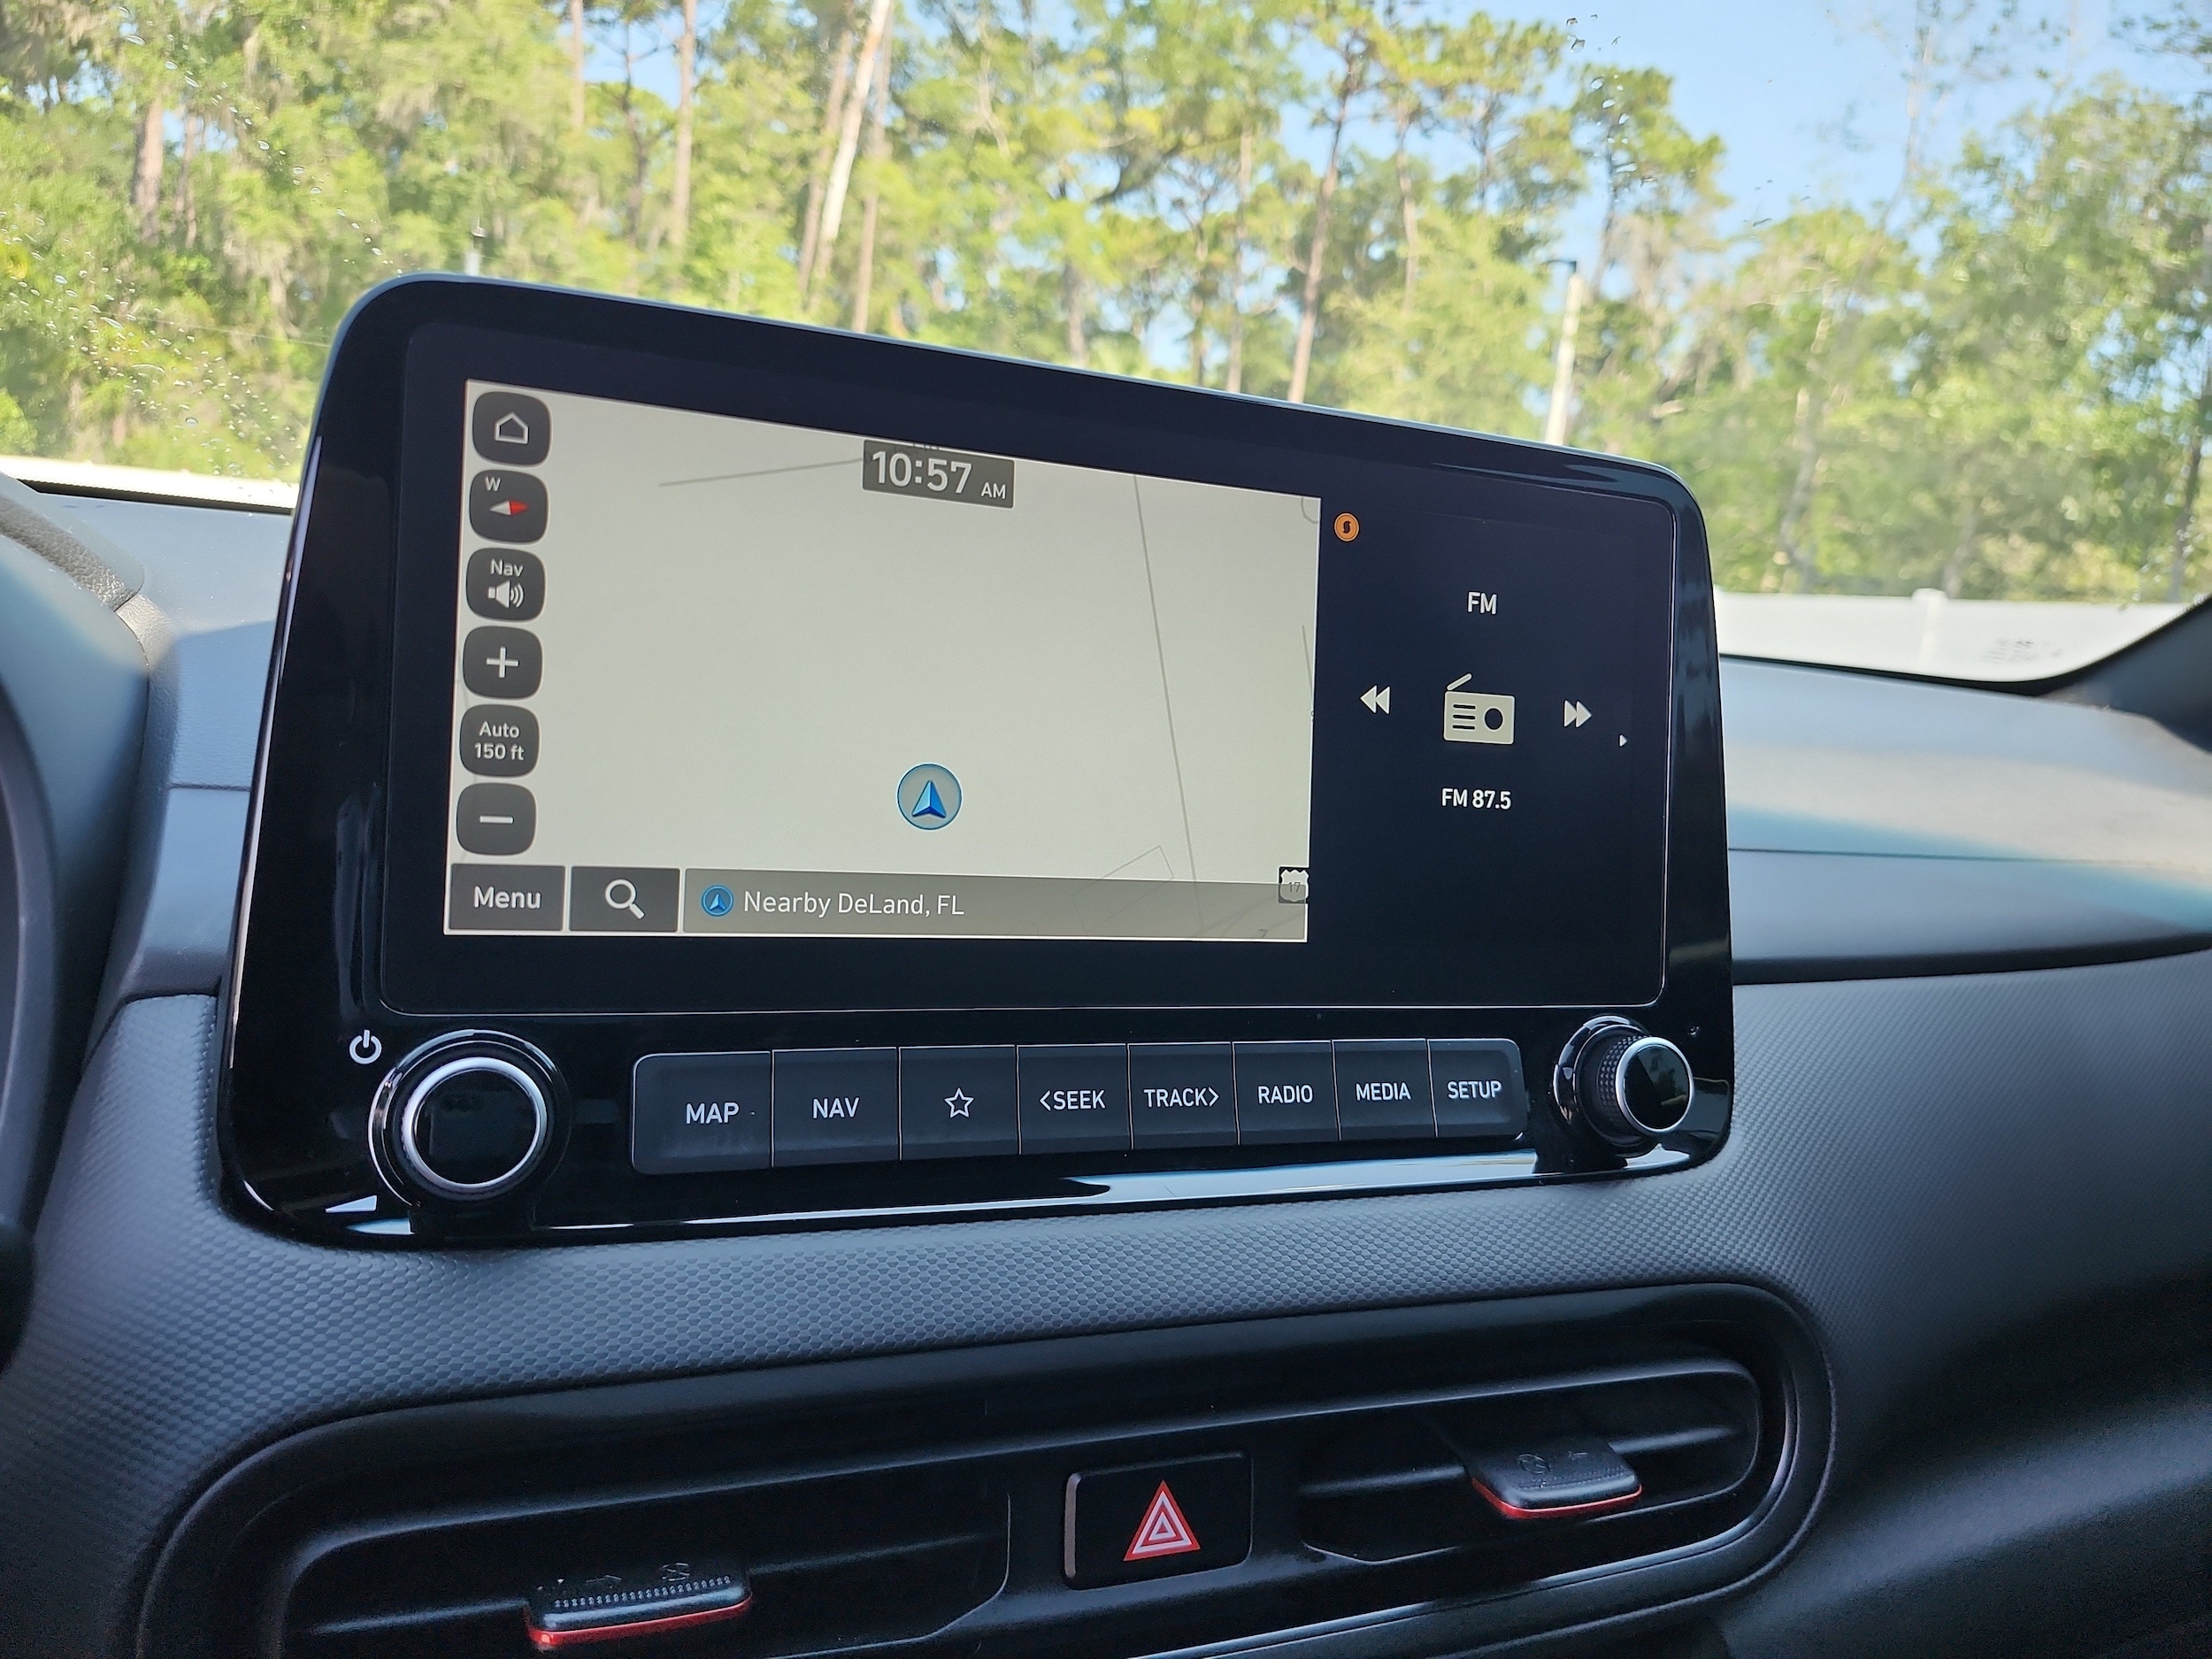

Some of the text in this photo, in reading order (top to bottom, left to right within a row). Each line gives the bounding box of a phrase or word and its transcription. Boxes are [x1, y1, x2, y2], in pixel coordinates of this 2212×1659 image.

[485, 475, 501, 492] W
[872, 450, 1007, 500] 10:57 AM
[490, 558, 524, 577] Nav
[1467, 591, 1498, 615] FM
[479, 720, 520, 739] Auto
[474, 742, 525, 761] 150 ft
[1441, 787, 1512, 810] FM 87.5
[1287, 881, 1302, 893] 17
[473, 886, 541, 910] Menu
[744, 890, 965, 918] Nearby DeLand, FL
[1257, 1084, 1314, 1105] RADIO
[1356, 1081, 1412, 1102] MEDIA
[1447, 1079, 1502, 1100] SETUP
[685, 1102, 740, 1125] MAP
[812, 1096, 860, 1119] NAV
